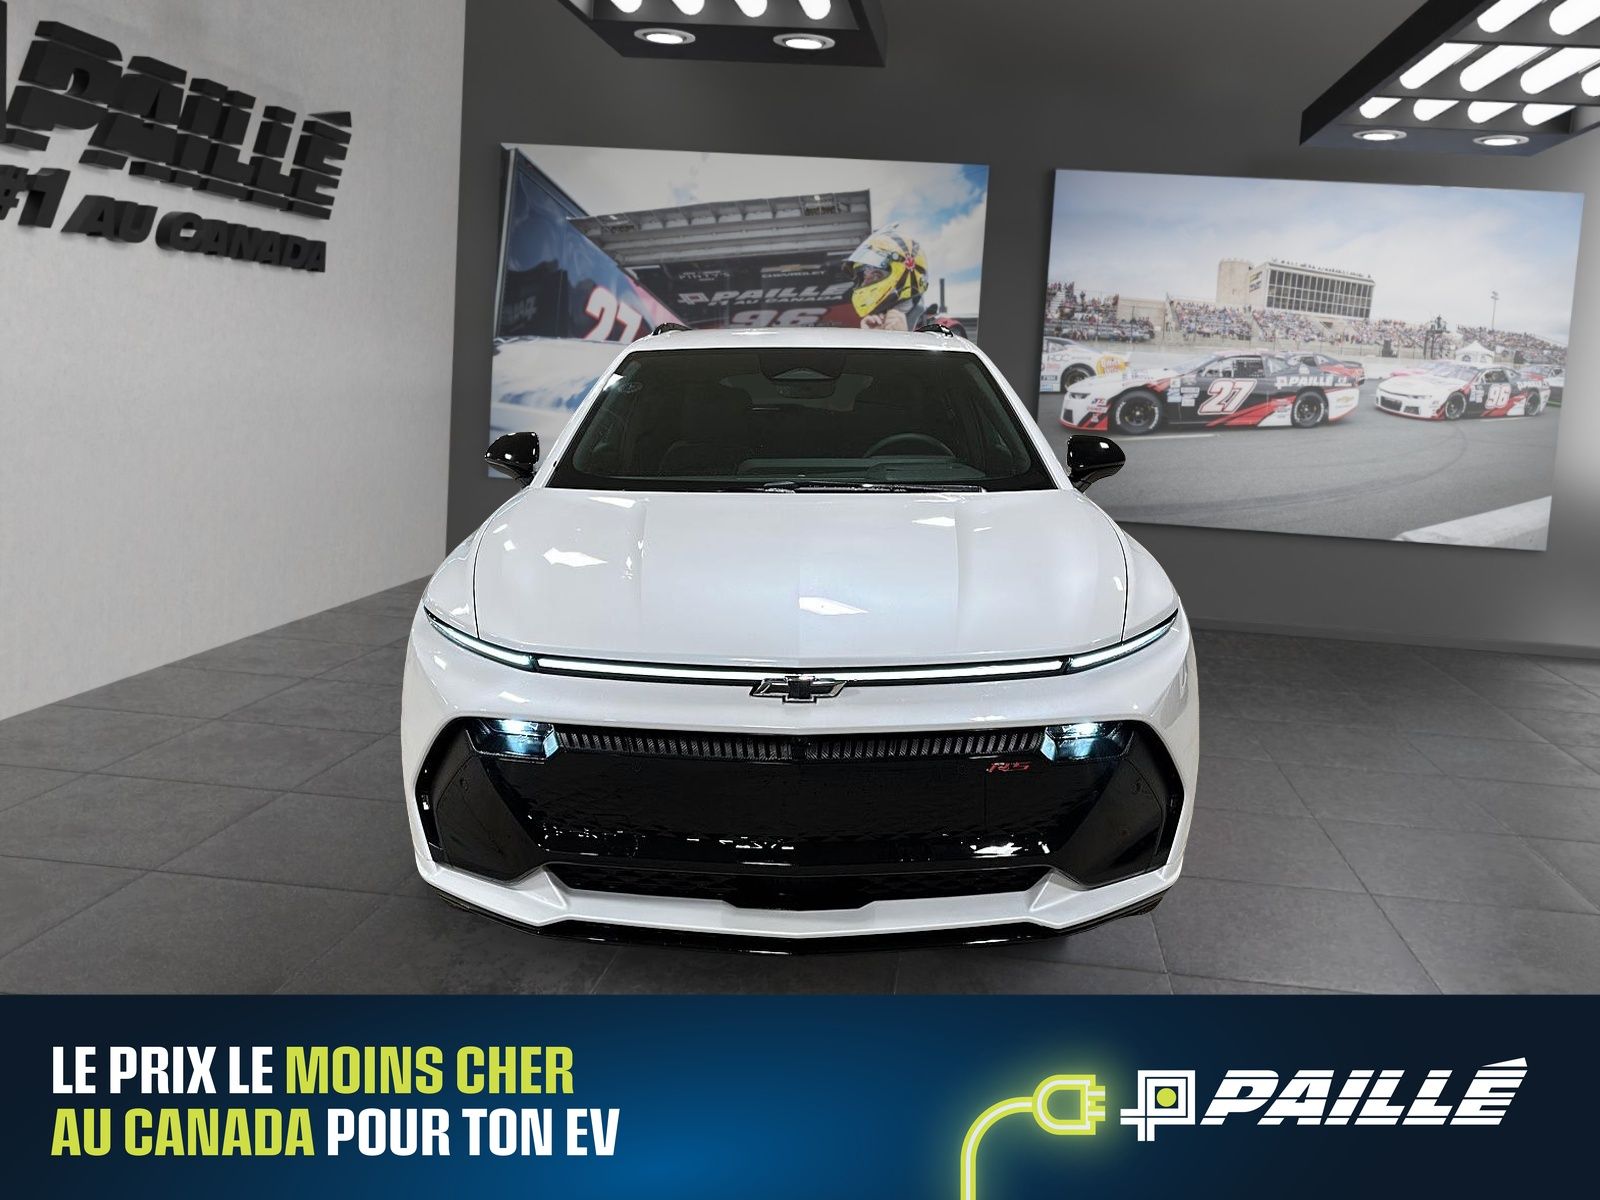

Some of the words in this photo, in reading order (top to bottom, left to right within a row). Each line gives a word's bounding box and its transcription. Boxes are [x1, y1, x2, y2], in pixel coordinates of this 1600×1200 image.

[60, 194, 158, 243] AU
[155, 211, 327, 272] CANADA
[583, 285, 643, 343] 27
[731, 307, 828, 329] 96
[1197, 378, 1257, 415] 27
[1484, 383, 1512, 409] 96
